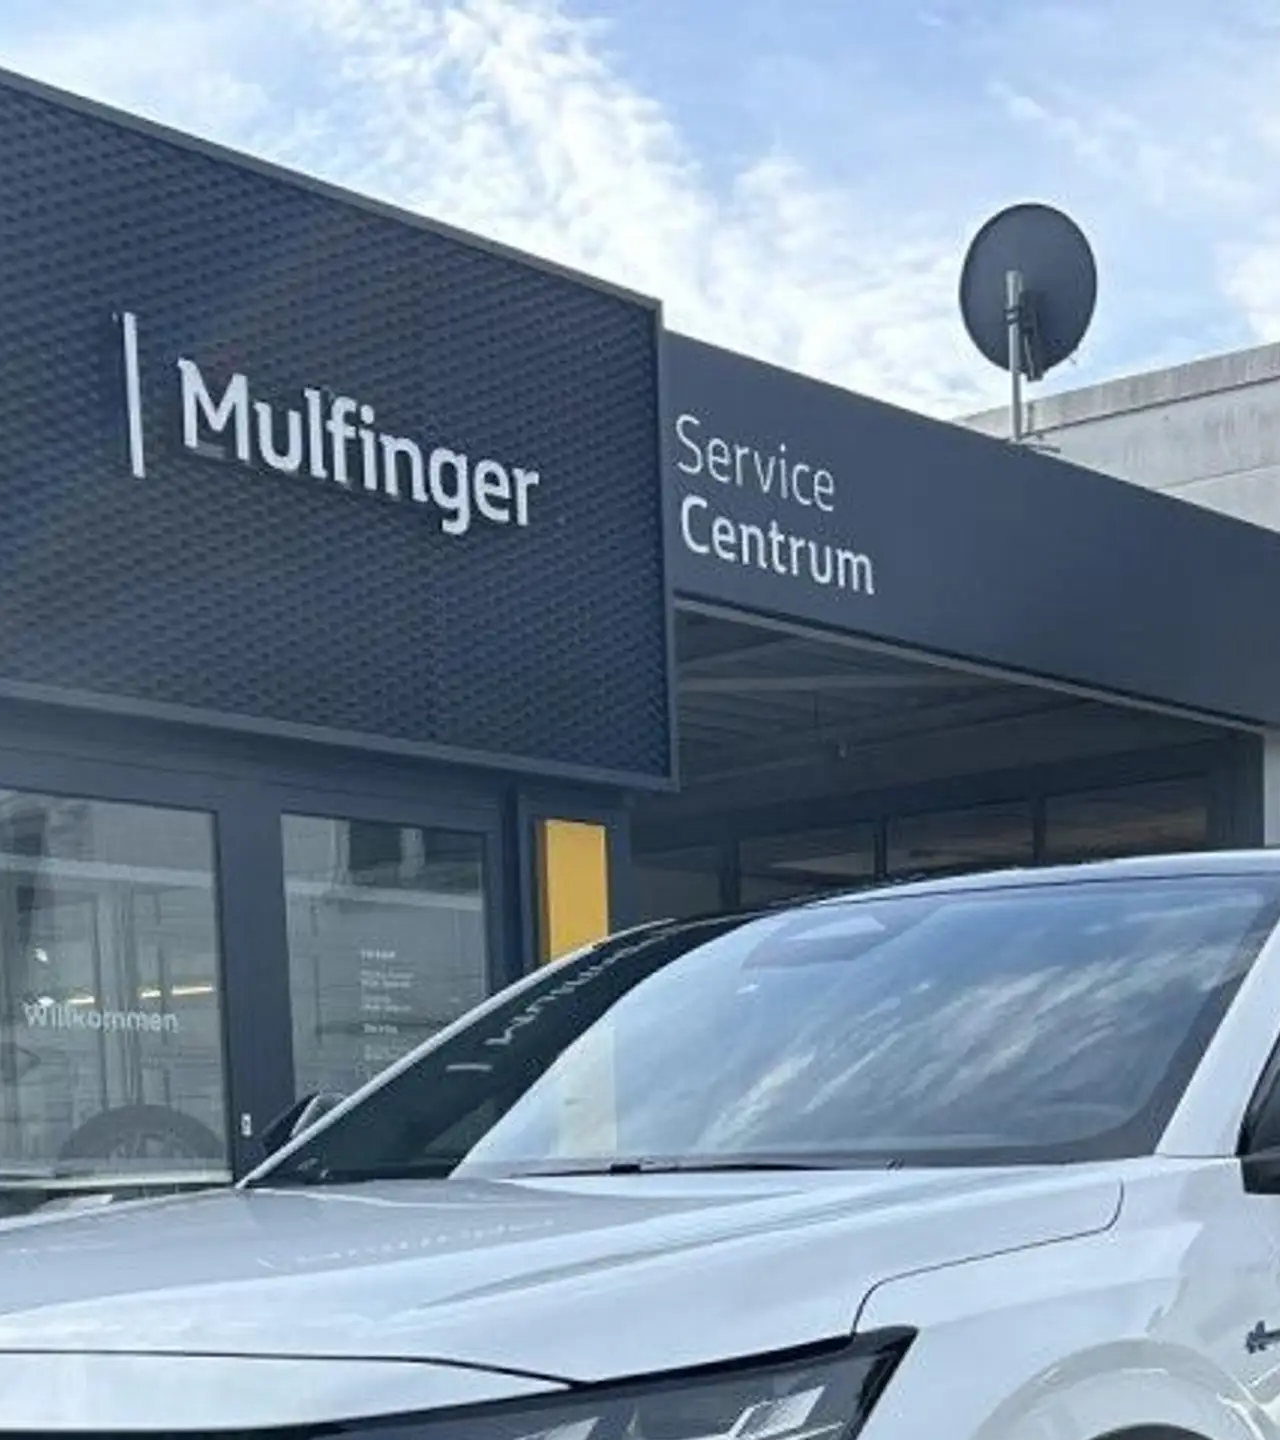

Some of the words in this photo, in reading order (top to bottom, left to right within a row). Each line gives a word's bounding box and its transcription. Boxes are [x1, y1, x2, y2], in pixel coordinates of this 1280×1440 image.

[177, 357, 540, 536] Mulfinger
[675, 413, 835, 512] Service
[680, 494, 876, 595] Centrum
[23, 1002, 180, 1034] Willkommen
